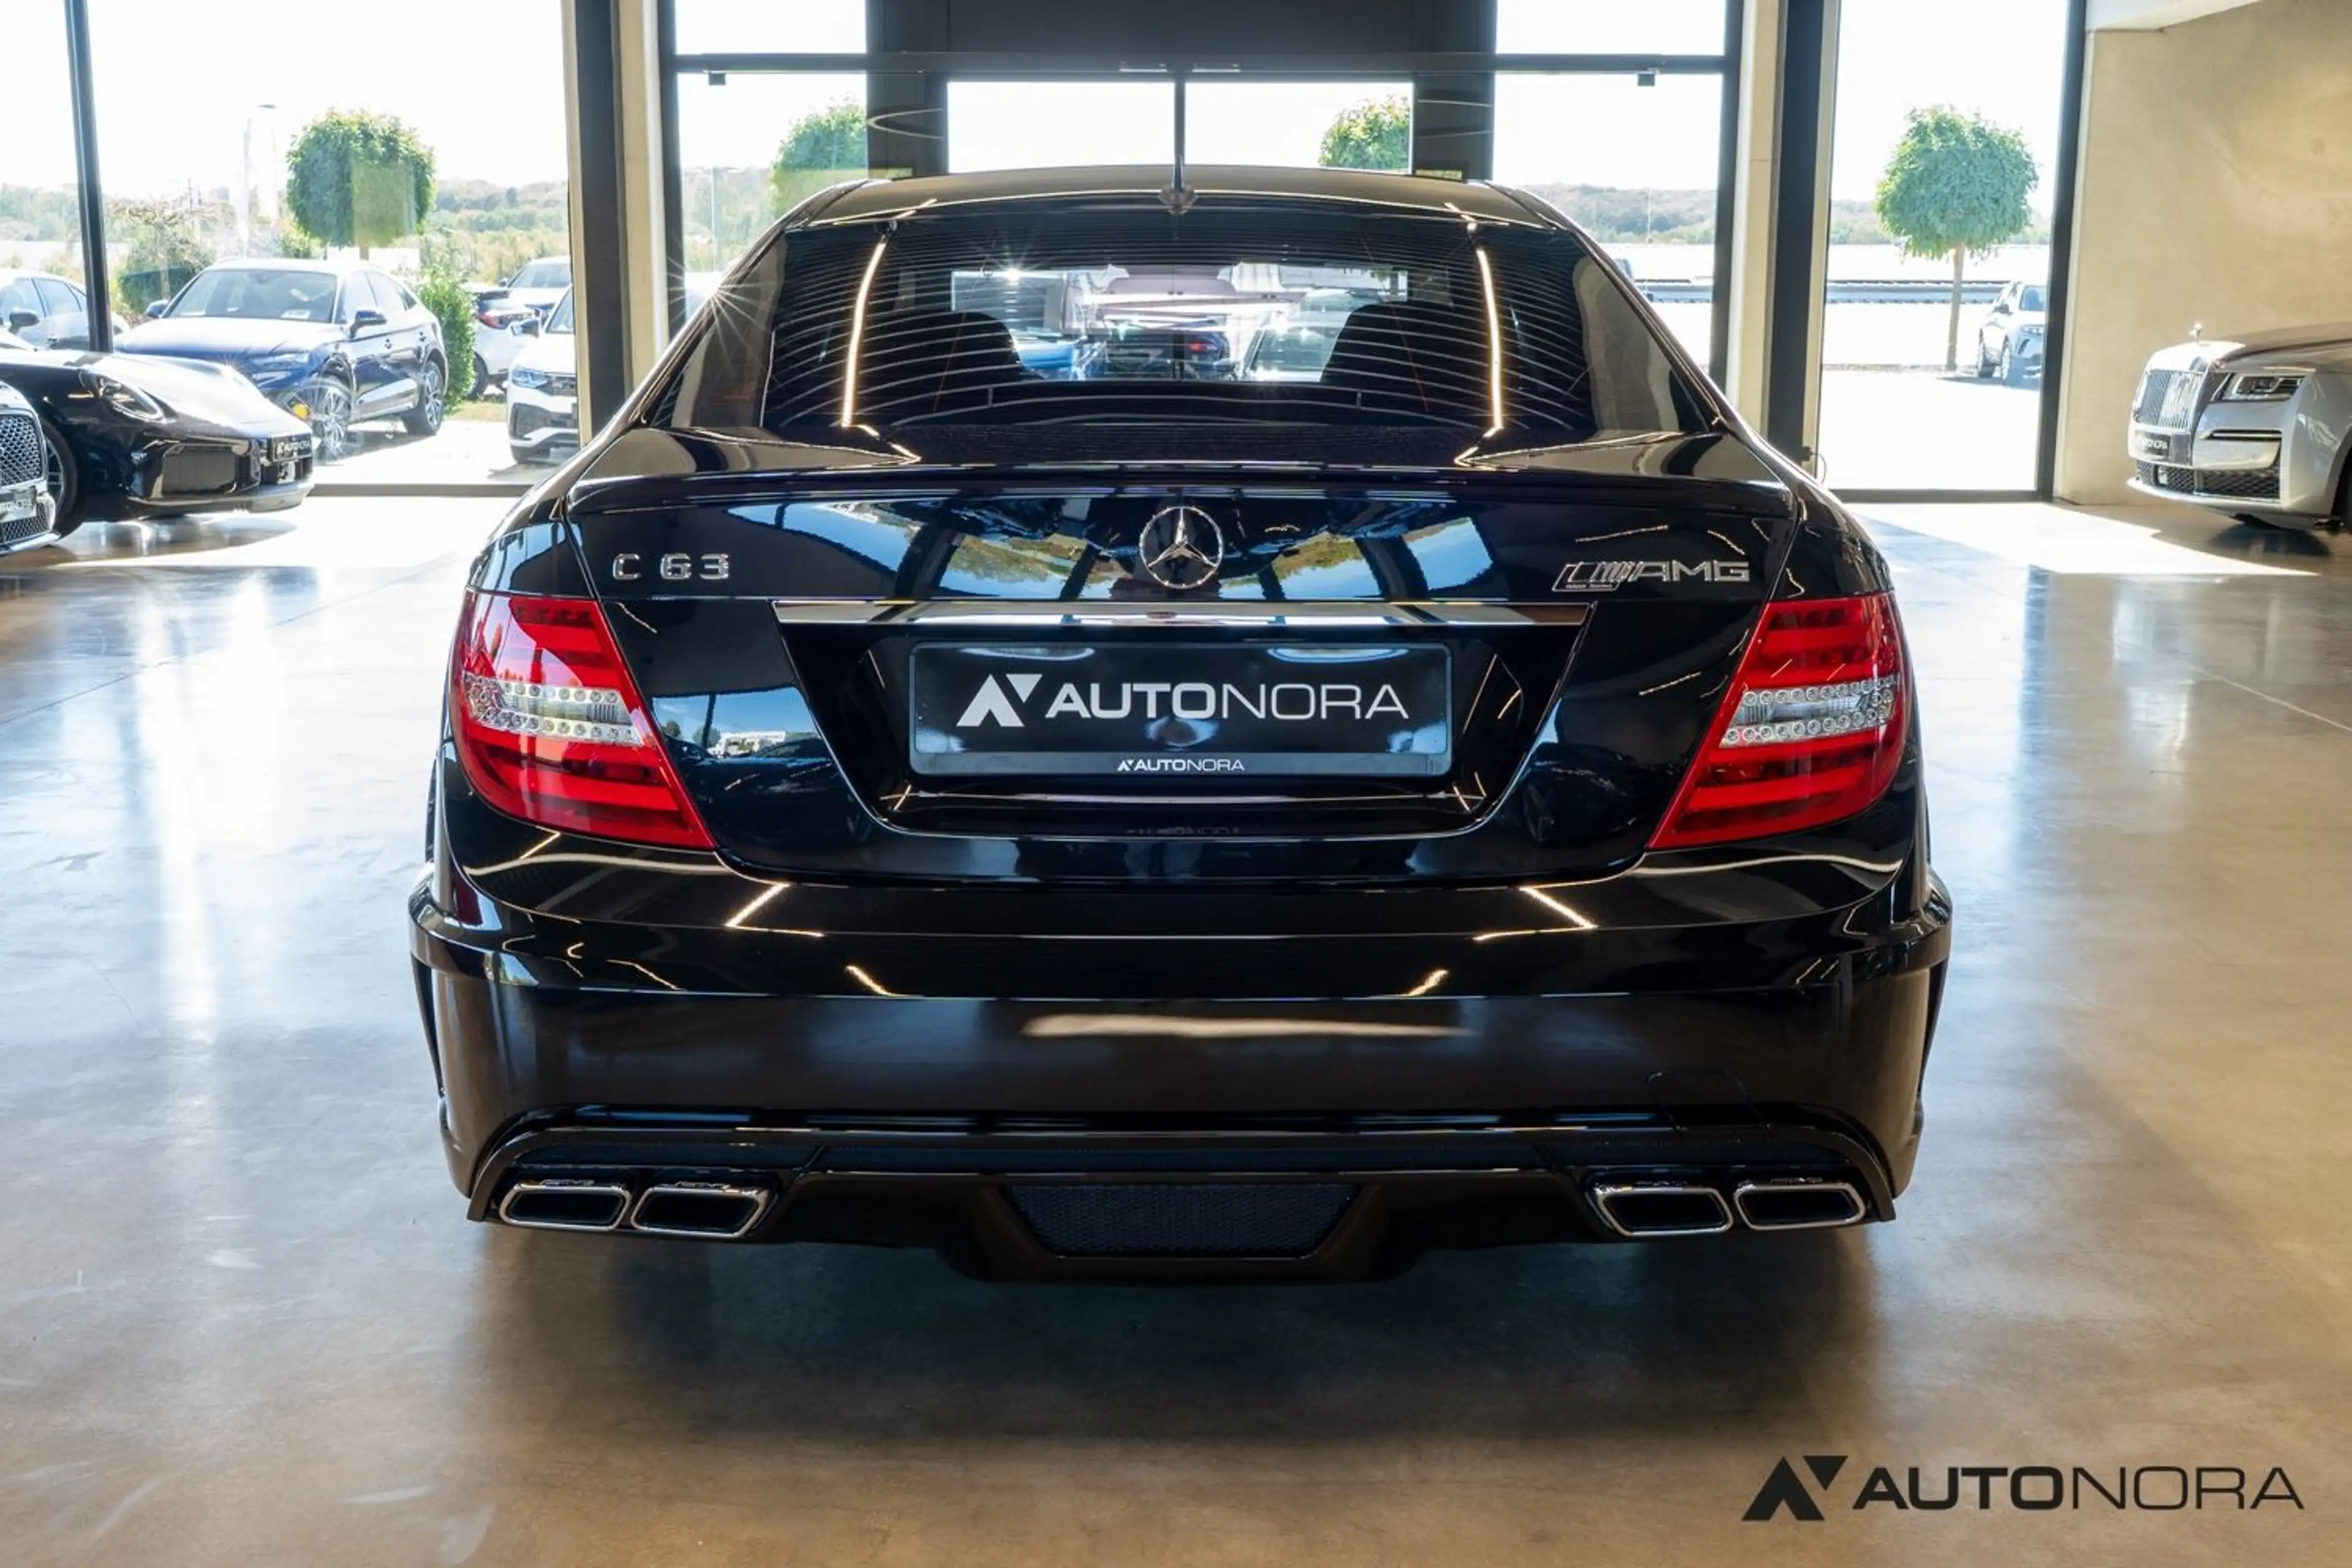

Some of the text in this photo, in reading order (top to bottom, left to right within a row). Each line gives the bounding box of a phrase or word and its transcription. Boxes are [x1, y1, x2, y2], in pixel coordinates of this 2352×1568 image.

[612, 554, 729, 579] C 63
[1629, 560, 1750, 581] AMG
[1045, 683, 1409, 719] AUTONORA
[1134, 759, 1245, 771] AUTONORA
